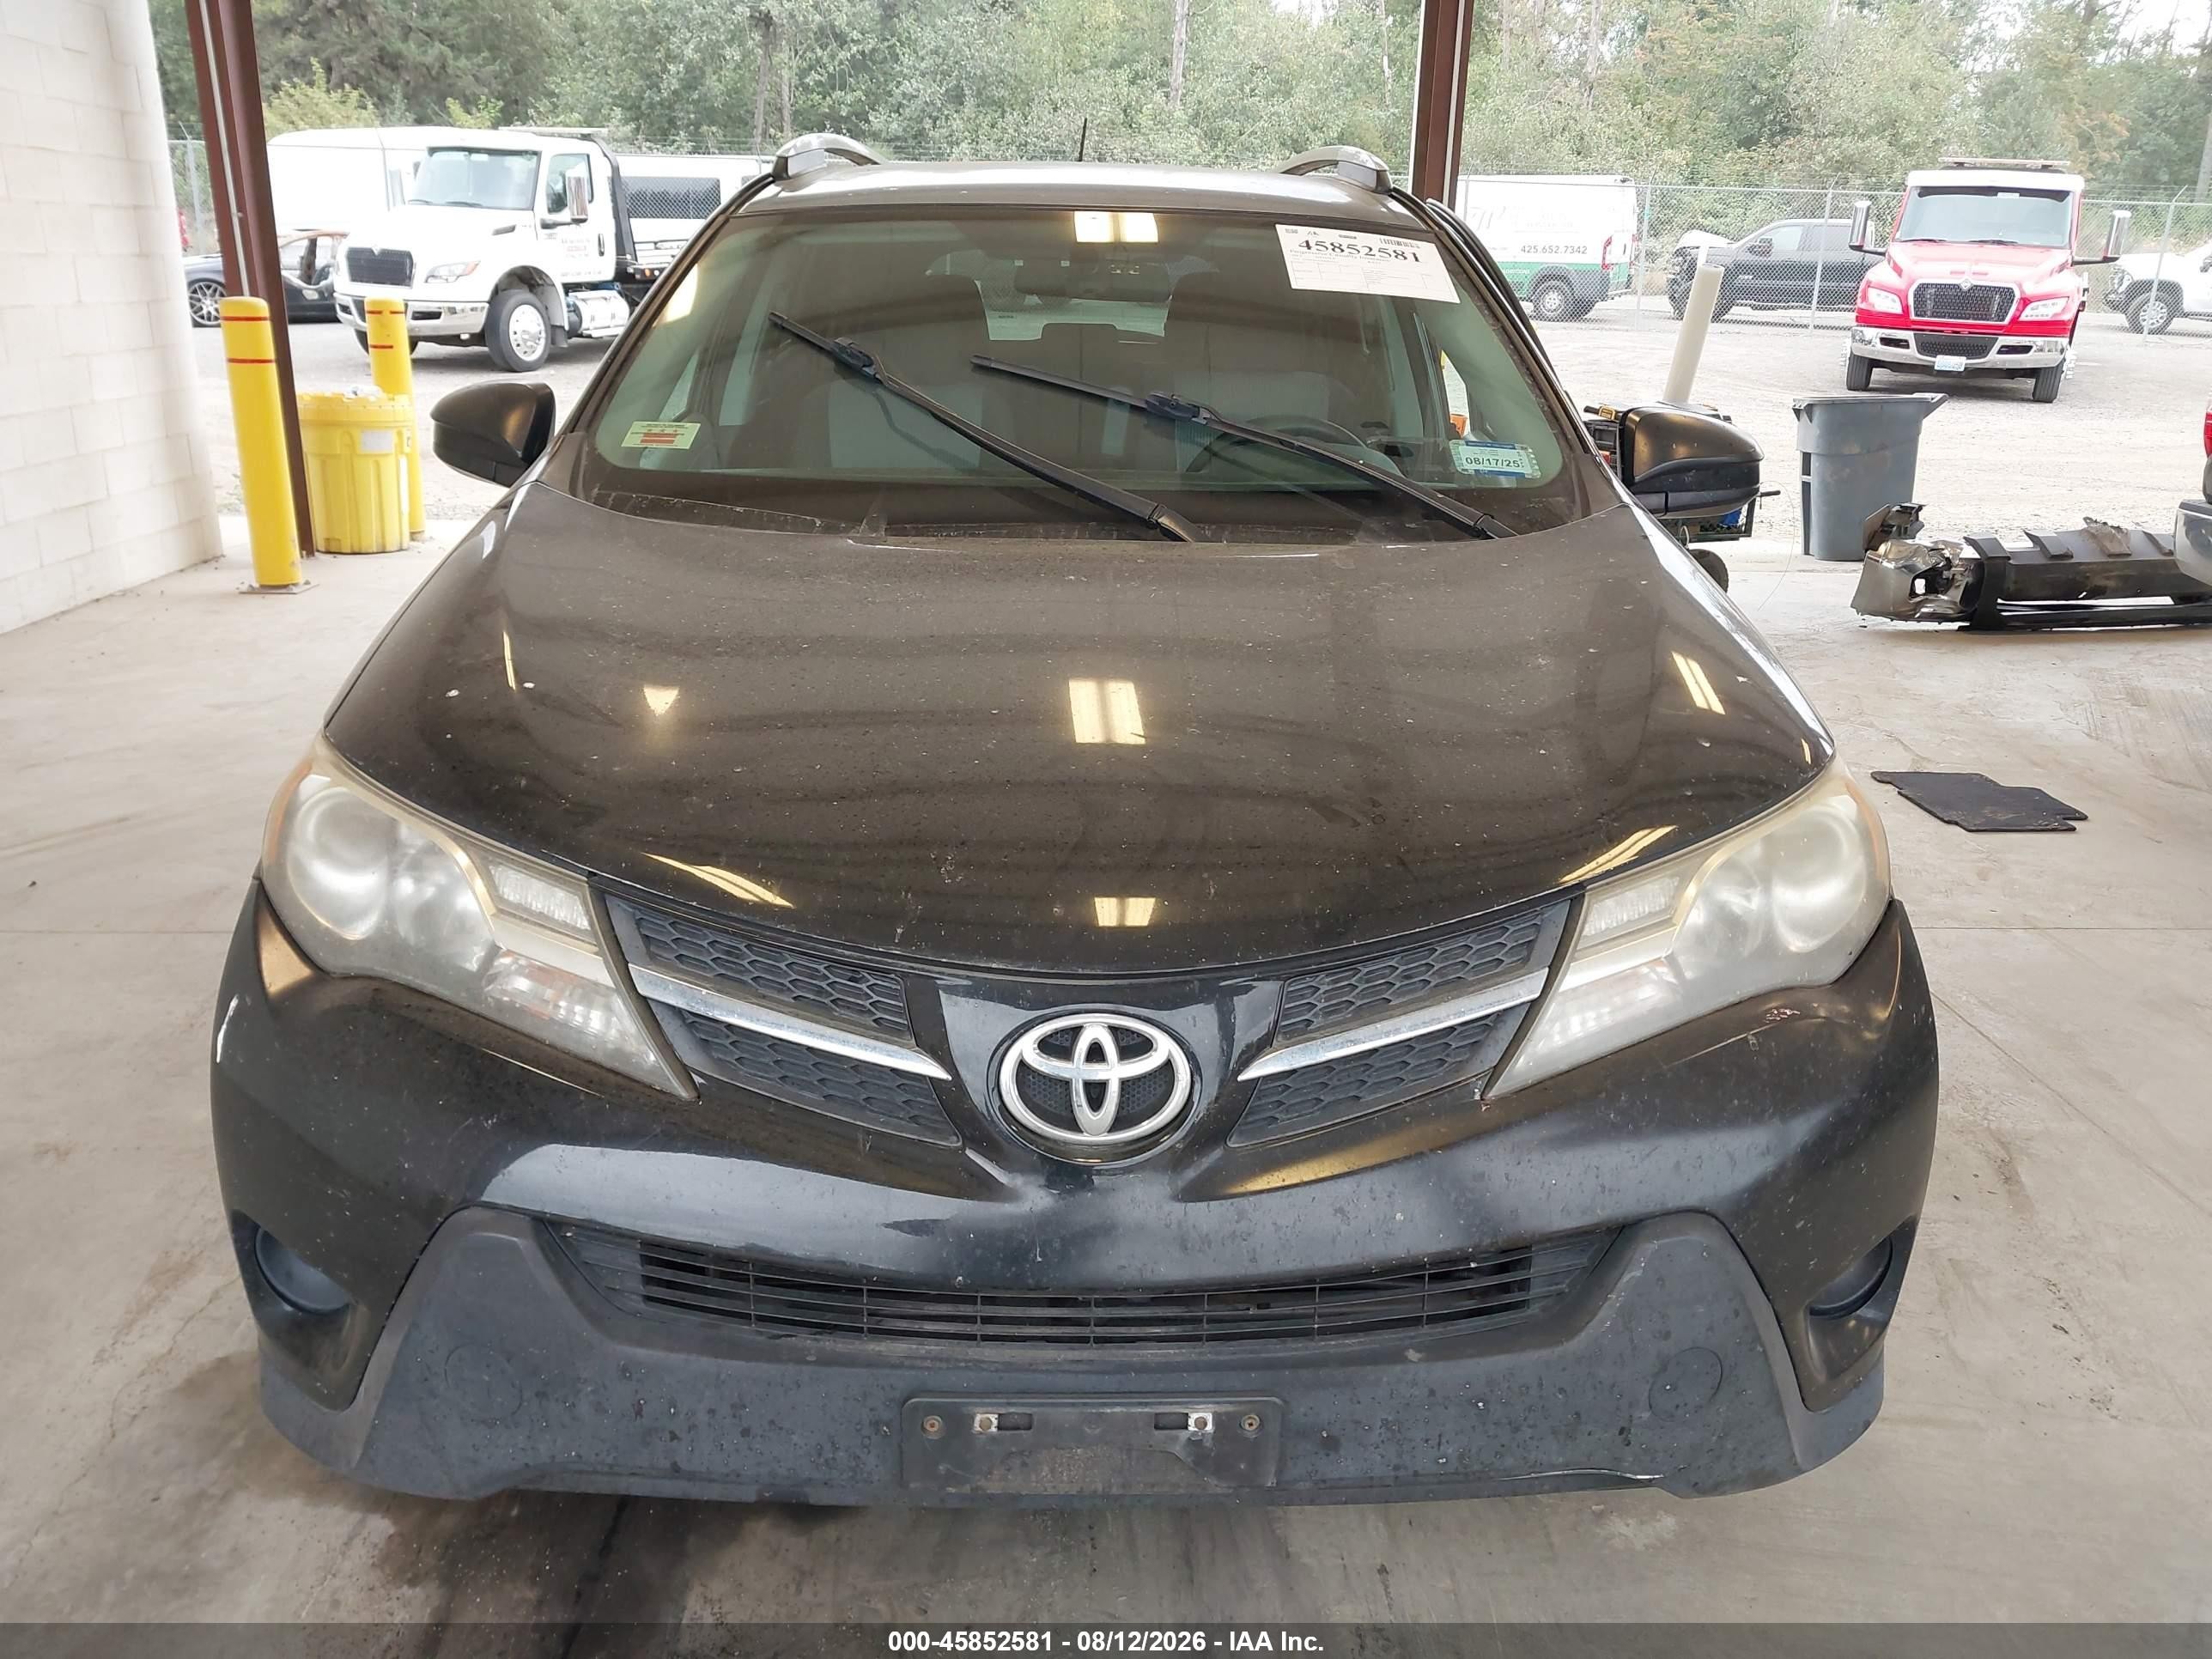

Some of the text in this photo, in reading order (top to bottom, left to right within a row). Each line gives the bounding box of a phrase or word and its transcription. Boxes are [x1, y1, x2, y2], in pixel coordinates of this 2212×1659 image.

[1298, 240, 1421, 263] 45852581
[1521, 246, 1588, 254] 425.652.7342
[1465, 457, 1520, 468] 08/17/25
